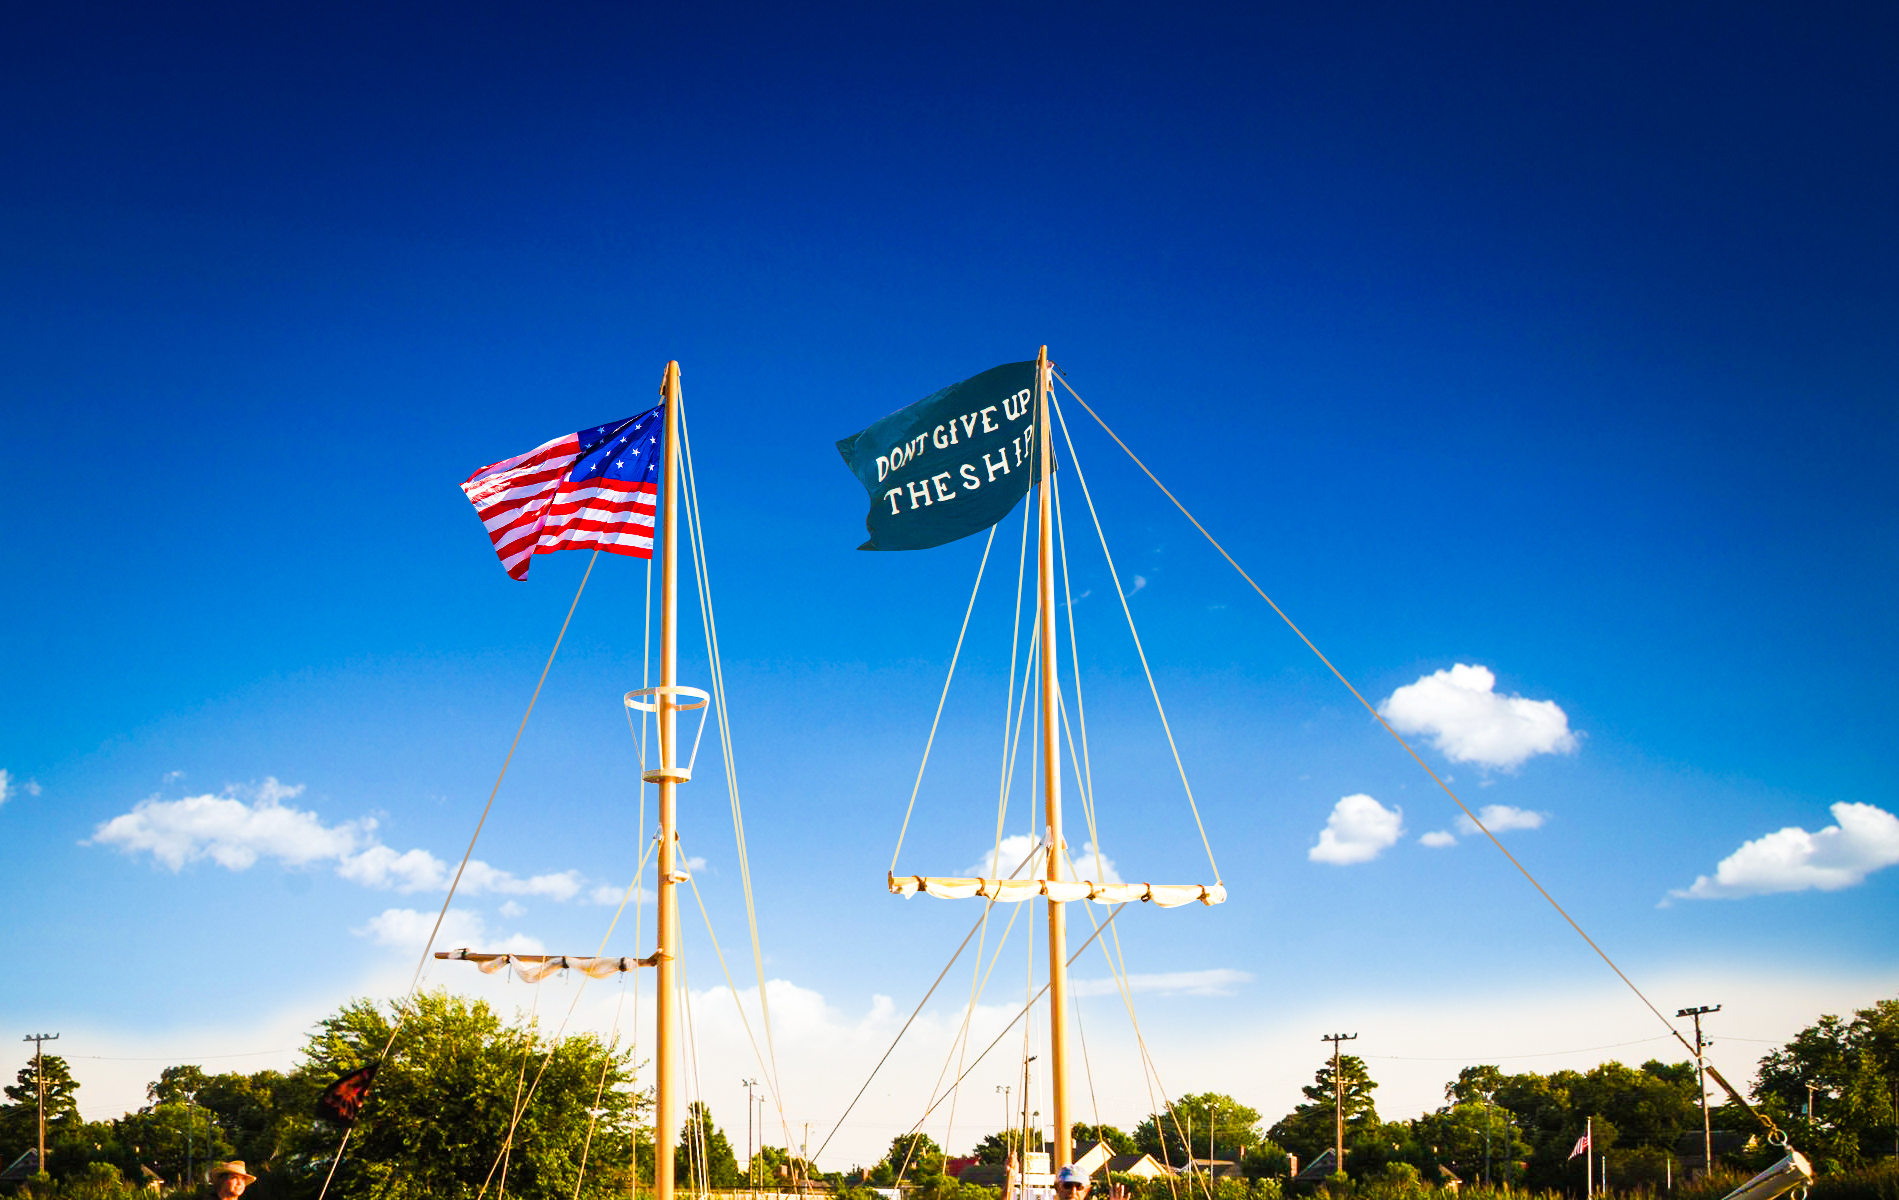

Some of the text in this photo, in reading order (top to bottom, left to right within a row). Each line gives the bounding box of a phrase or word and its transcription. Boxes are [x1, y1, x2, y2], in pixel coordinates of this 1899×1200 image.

[876, 388, 1031, 482] DONT GIVE UP
[884, 424, 1033, 515] THE SHIP
